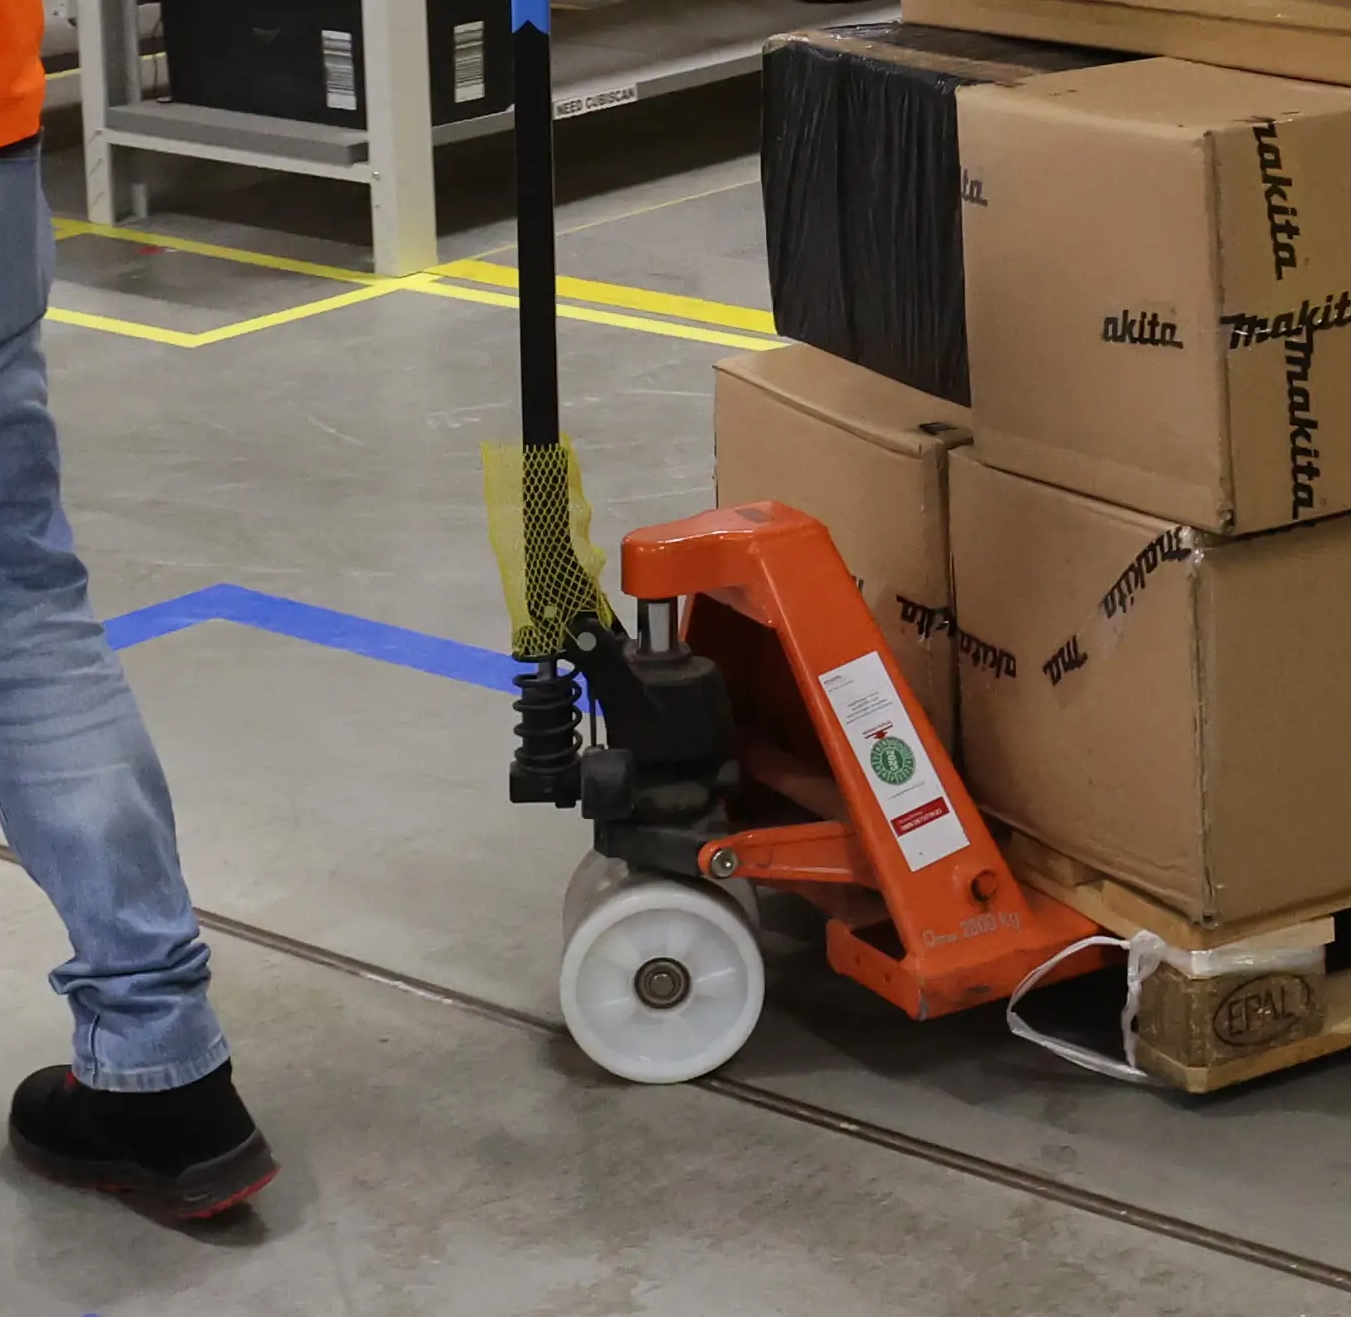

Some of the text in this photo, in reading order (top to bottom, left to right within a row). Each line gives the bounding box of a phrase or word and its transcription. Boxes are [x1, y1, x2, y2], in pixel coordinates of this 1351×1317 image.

[1101, 309, 1184, 350] akita
[1284, 328, 1321, 521] makita
[1227, 985, 1297, 1037] EPAL
